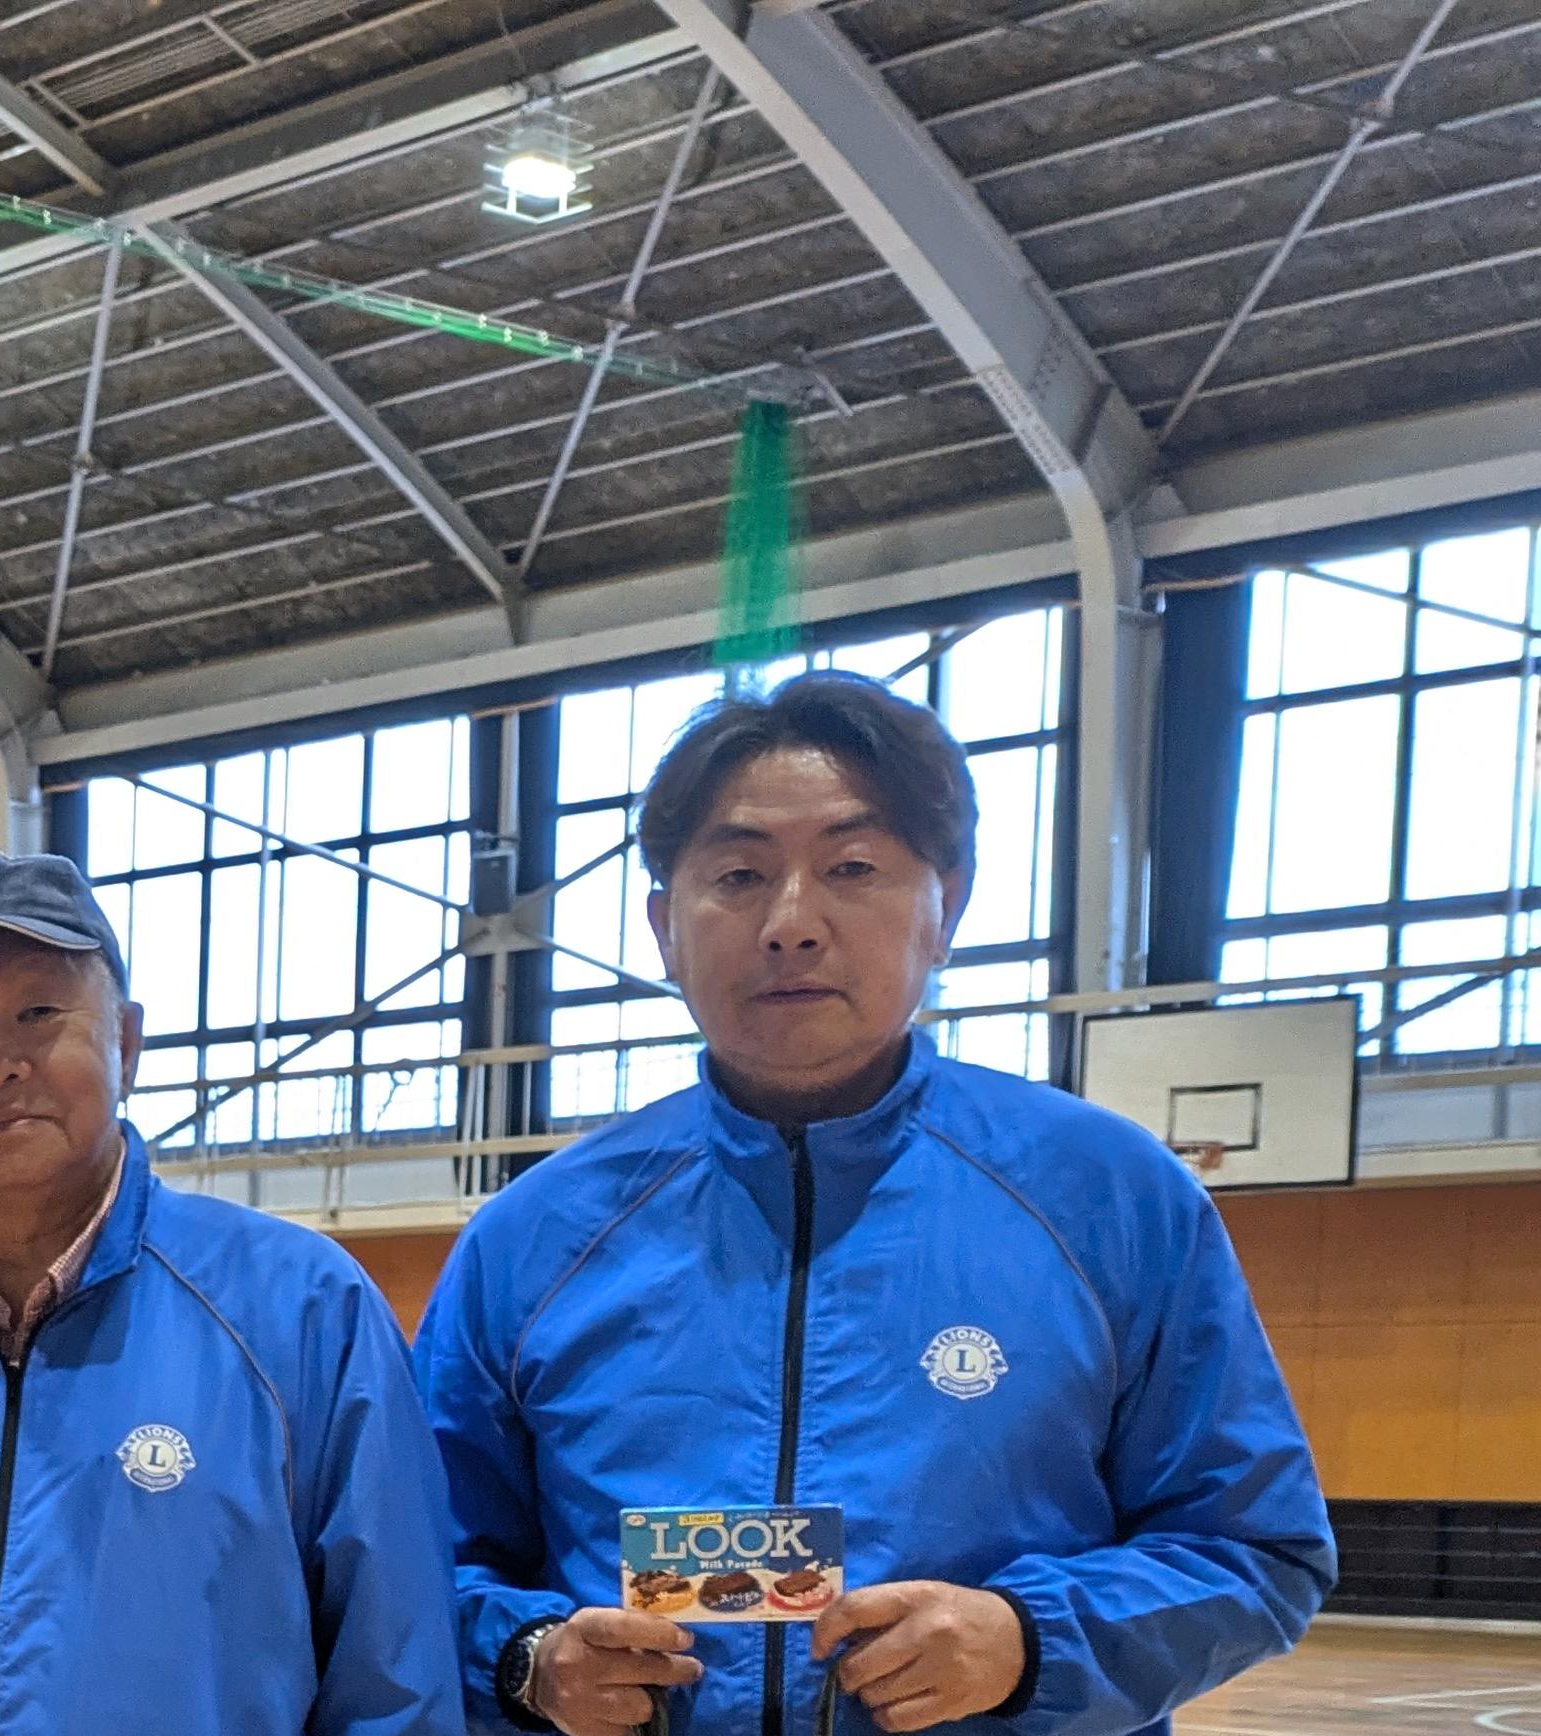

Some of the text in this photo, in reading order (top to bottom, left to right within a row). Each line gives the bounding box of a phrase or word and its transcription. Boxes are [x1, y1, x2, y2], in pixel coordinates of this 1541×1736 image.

[938, 1329, 992, 1348] LIONS
[956, 1349, 976, 1372] L
[135, 1427, 184, 1446] LIONS
[147, 1444, 167, 1468] L
[650, 1518, 814, 1560] LOOK
